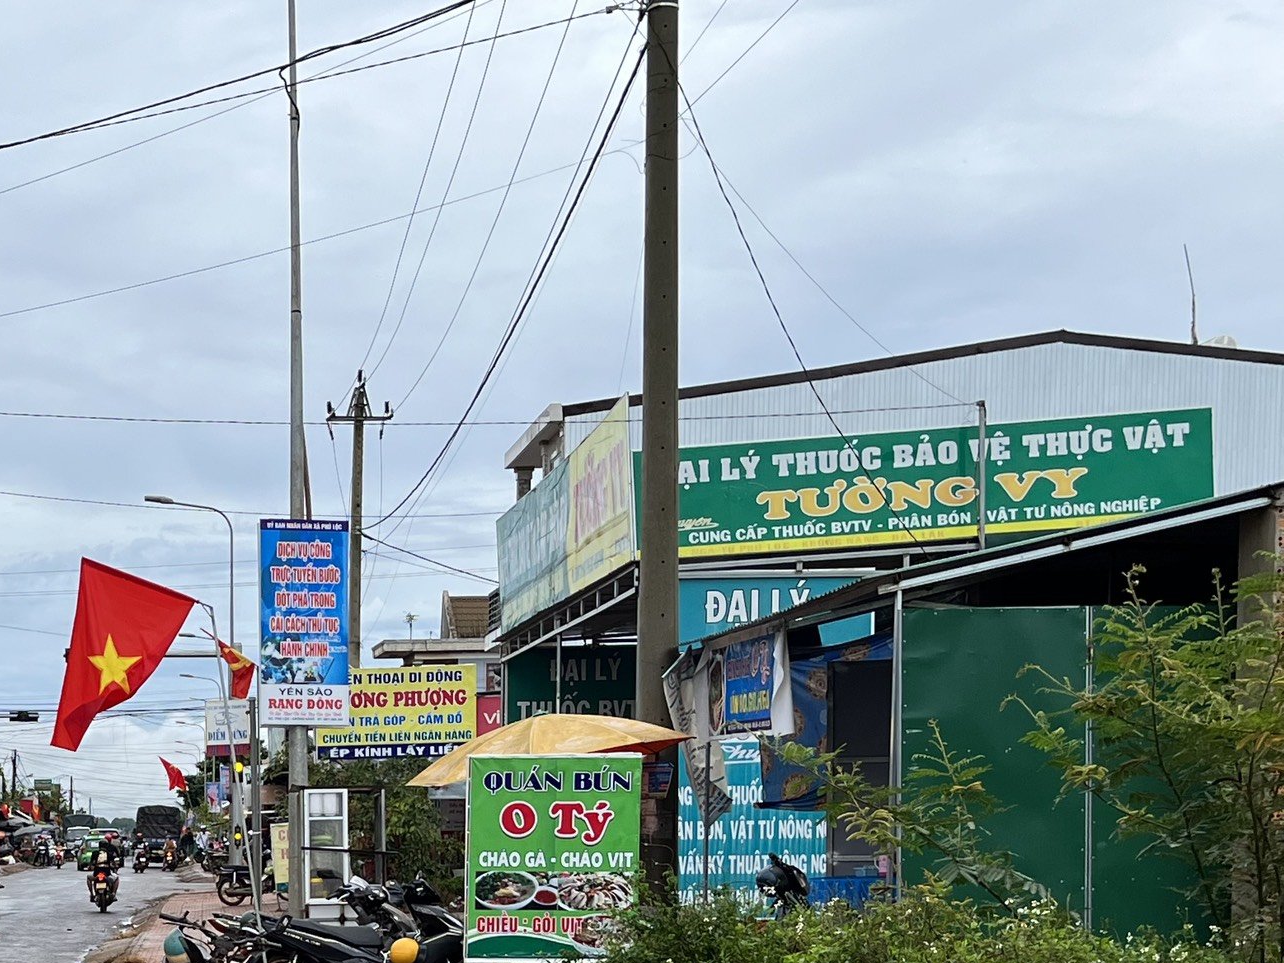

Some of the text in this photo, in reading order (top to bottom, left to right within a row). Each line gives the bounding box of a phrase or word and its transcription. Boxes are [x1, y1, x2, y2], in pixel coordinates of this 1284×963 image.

[678, 418, 1190, 490] ẠI LÝ THUỐC BẢO VỆ THỰC VẬT
[755, 467, 1089, 520] TƯỜNG VY
[688, 529, 732, 544] CUNG
[735, 523, 768, 541] CẤP
[771, 519, 826, 538] THUỐC
[834, 519, 872, 534] BVTV
[887, 513, 932, 530] PHÂN
[937, 511, 971, 526] BÓN
[987, 506, 1018, 523] VẬT
[1023, 503, 1046, 519] TƯ
[1050, 501, 1096, 518] NÔNG
[1100, 495, 1162, 514] NGHIỆP
[277, 539, 332, 562] DỊCH VỤ CÔNG
[270, 562, 341, 586] TRỰC TUYẾN BƯỚC
[292, 589, 309, 609] PHÁ
[309, 592, 336, 609] TRONG
[704, 589, 759, 627] ĐẠI
[285, 613, 306, 633] CÁCH
[306, 612, 324, 633] THỦ
[324, 616, 340, 636] TỤC
[366, 671, 405, 687] THOẠI
[409, 671, 422, 683] DI
[426, 670, 462, 685] ĐỘNG
[549, 651, 622, 686] ĐẠI LÝ
[393, 687, 467, 710] PHƯỢNG
[359, 712, 380, 726] TRẢ
[383, 713, 406, 726] GÓP
[329, 745, 350, 758] ÉP
[354, 745, 392, 757] KÍNH
[397, 743, 425, 756] LẤY
[483, 765, 632, 794] QUÁN BÚN
[499, 800, 615, 845] O Tý
[730, 815, 755, 844] VẬT
[757, 815, 776, 840] TƯ
[778, 814, 813, 840] NÔNG
[478, 849, 521, 868] CHÁO
[524, 849, 547, 868] GÀ
[560, 849, 605, 868] CHÁO
[707, 850, 725, 875] KỸ
[476, 910, 519, 934] CHIỀU
[532, 911, 557, 934] GỎI
